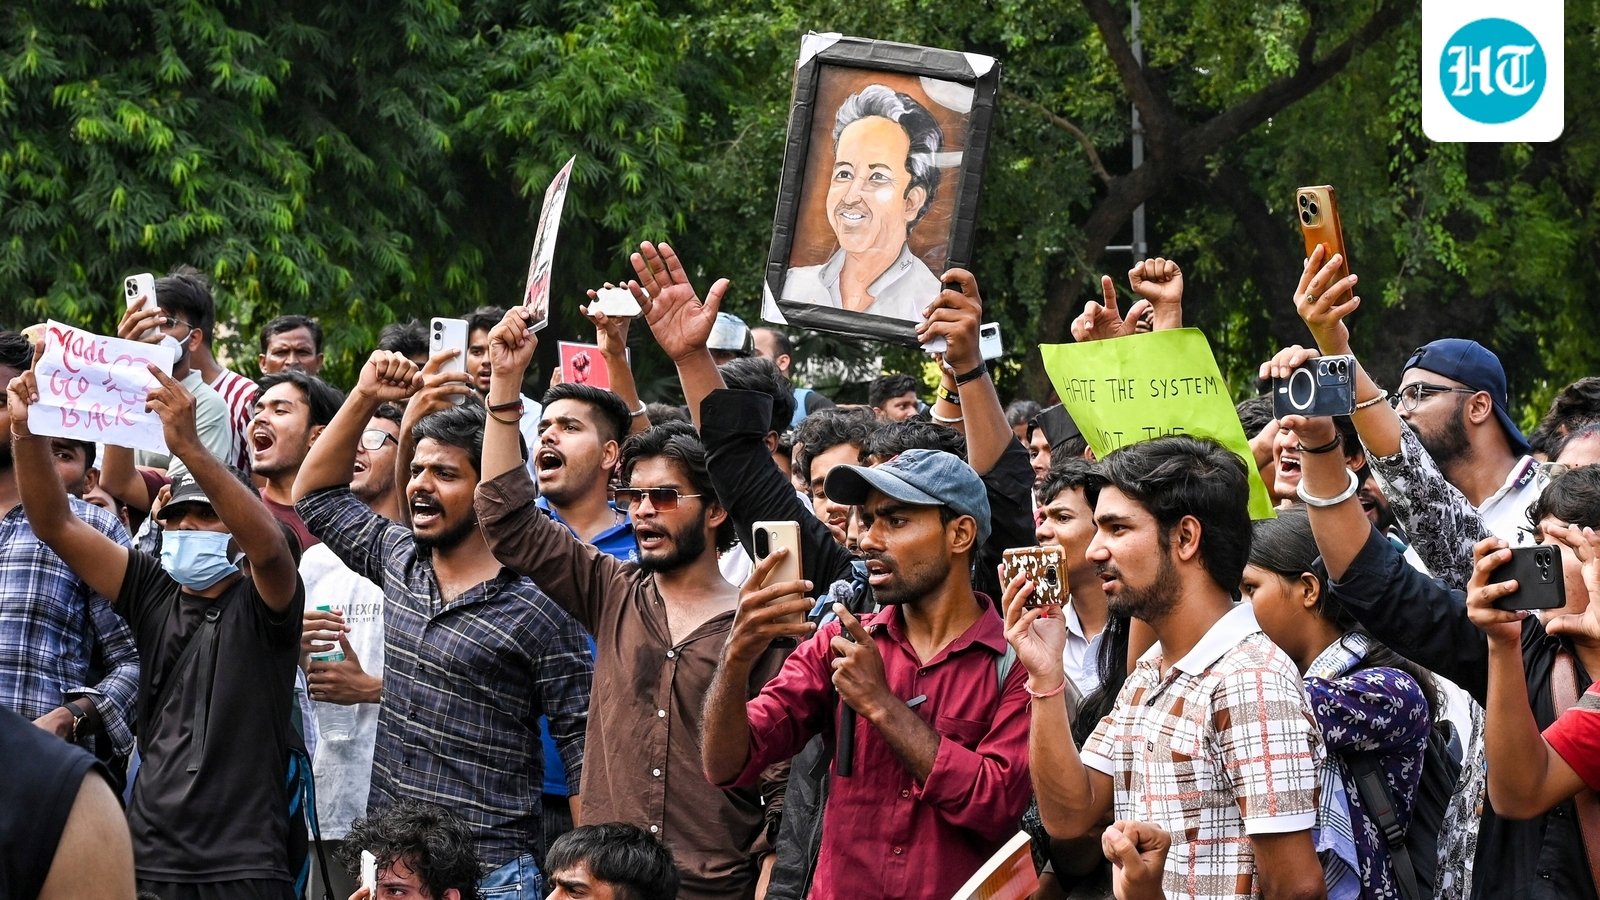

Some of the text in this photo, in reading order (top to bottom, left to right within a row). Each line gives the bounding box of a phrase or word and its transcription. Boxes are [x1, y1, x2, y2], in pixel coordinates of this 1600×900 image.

[1062, 376, 1218, 402] HATE THE SYSTEM
[60, 401, 135, 431] BACK
[1096, 427, 1123, 450] NOT
